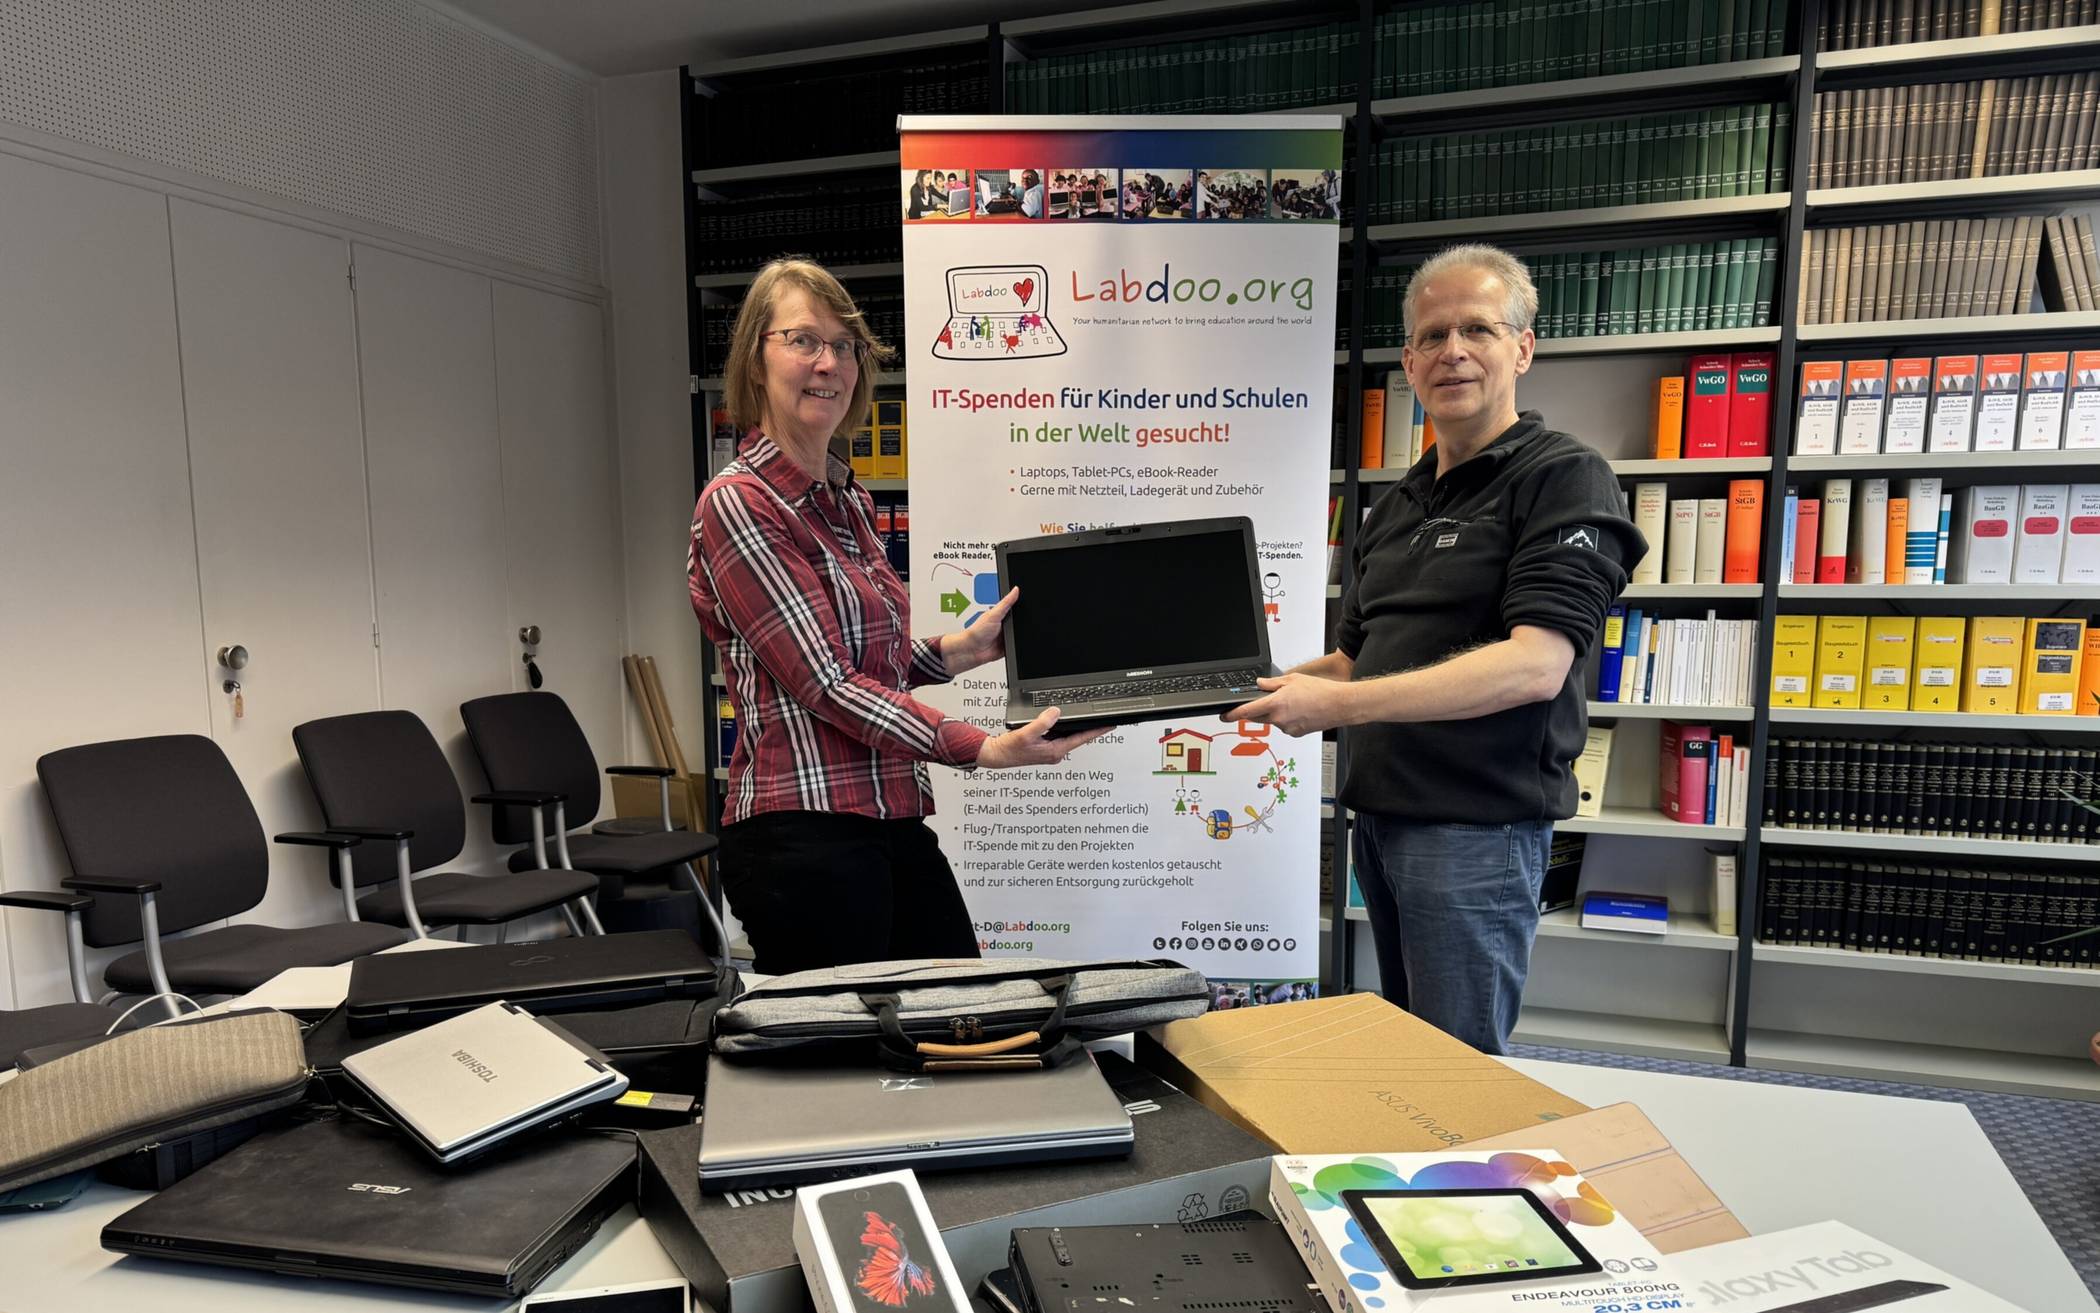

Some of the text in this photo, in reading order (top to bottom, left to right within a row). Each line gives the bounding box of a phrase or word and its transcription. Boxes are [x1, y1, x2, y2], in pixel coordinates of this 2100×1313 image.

[962, 285, 1007, 299] Labdoo
[1072, 262, 1313, 311] Labdoo.org
[1091, 317, 1142, 325] humanitarian
[1141, 317, 1171, 326] network
[1186, 317, 1205, 326] bring
[1206, 316, 1245, 325] education
[1248, 316, 1274, 324] around
[1291, 316, 1312, 324] world
[1698, 374, 1768, 384] VwGO VwGO
[933, 387, 1307, 413] IT-Spenden für Kinder und Schulen
[1011, 422, 1229, 447] in der Welt gesucht!
[1021, 466, 1219, 479] Laptops, Tablet-PCs, eBook-Reader
[1021, 484, 1264, 498] Gerne mit Netzteil, Ladegerät und Zubehör
[1040, 523, 1063, 534] Wie
[1067, 523, 1086, 533] Sie
[962, 552, 993, 560] Reader,
[1258, 552, 1303, 560] T-Spenden.
[947, 598, 956, 608] 1.
[964, 680, 996, 689] Daten
[964, 697, 1007, 707] mit Zufa
[964, 717, 1006, 728] Kindger
[1087, 734, 1124, 745] prache
[1689, 742, 1703, 750] GG
[963, 770, 1113, 782] Der Spender kann den Weg
[964, 787, 1110, 800] seiner IT-Spende verfolgen
[964, 803, 1148, 816] (E-Mail des Spenders erforderlich)
[964, 823, 1148, 836] Flug-/Transportpaten nehmen die
[964, 840, 1018, 853] IT-Spende
[1021, 840, 1039, 850] mit
[1057, 840, 1078, 850] den
[1081, 840, 1134, 853] Projekten
[964, 859, 1222, 872] Irreparable Geräte werden kostenlos getauscht
[964, 876, 1194, 889] und zur sicheren Entsorgung zurückgeholt
[972, 921, 1070, 933] t-D@Labdoo.org
[1182, 920, 1268, 933] Folgen Sie uns:
[451, 1049, 498, 1083] TOSHIBA
[1368, 1090, 1418, 1113] ASUS
[346, 1183, 412, 1194] ASUS
[1797, 1250, 1893, 1278] Tab
[1512, 1283, 1680, 1302] ENDEAVOUR 800NG
[1561, 1293, 1685, 1307] MULTITOUCH HD-DISPLAY
[1594, 1303, 1642, 1313] 20,3
[1647, 1299, 1682, 1310] CM
